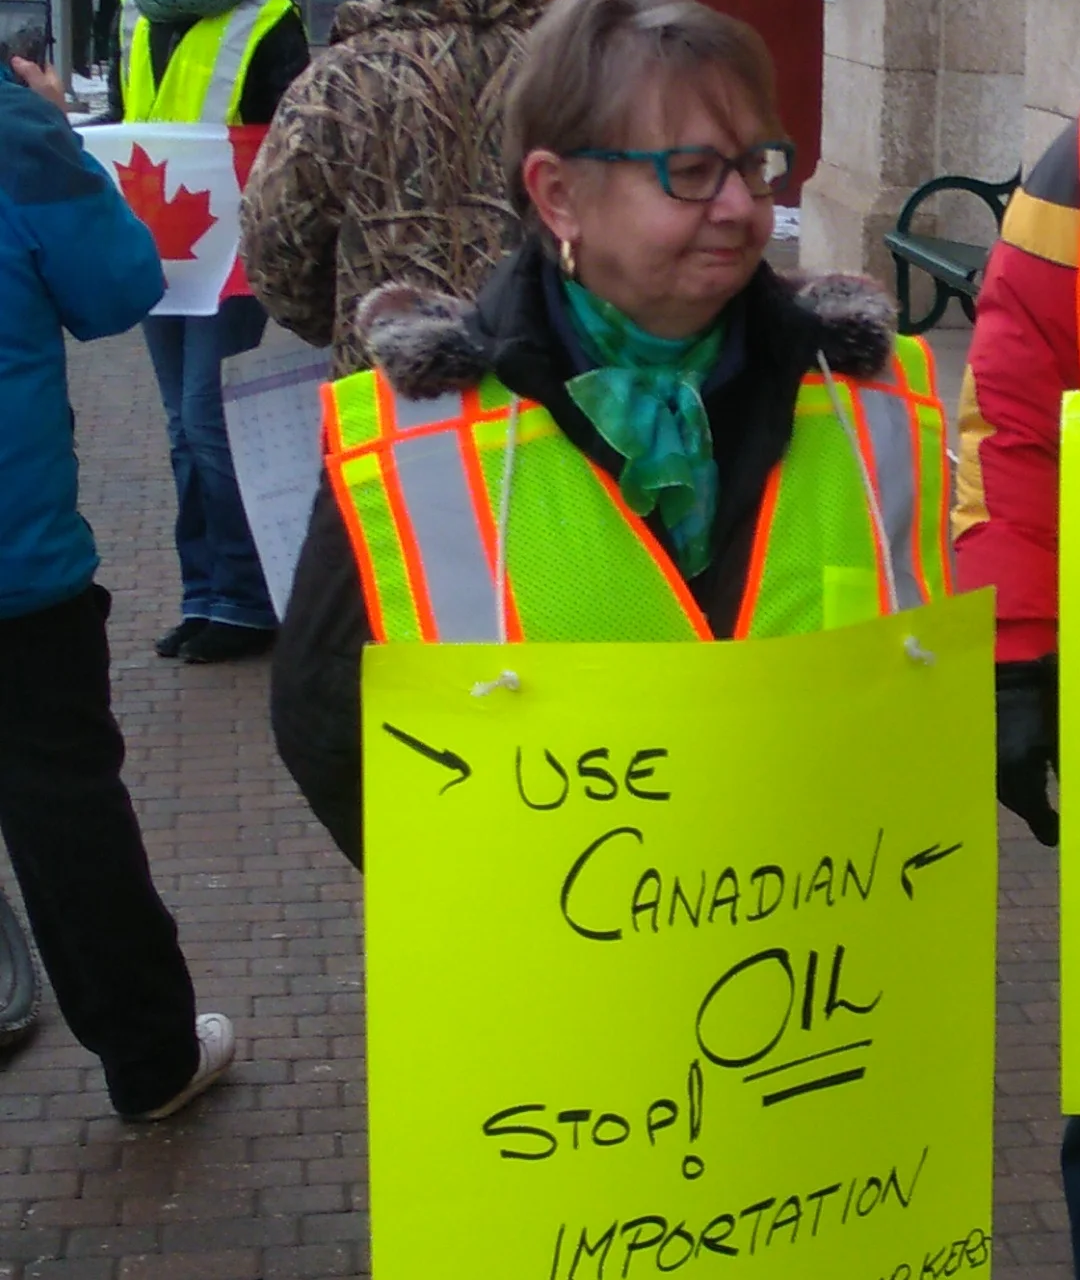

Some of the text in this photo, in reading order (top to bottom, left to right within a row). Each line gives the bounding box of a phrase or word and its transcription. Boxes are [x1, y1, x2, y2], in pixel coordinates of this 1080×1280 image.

[515, 746, 672, 811] USE
[559, 826, 883, 942] CANADIAN
[695, 943, 883, 1068] OIL
[482, 1058, 705, 1180] STOP!
